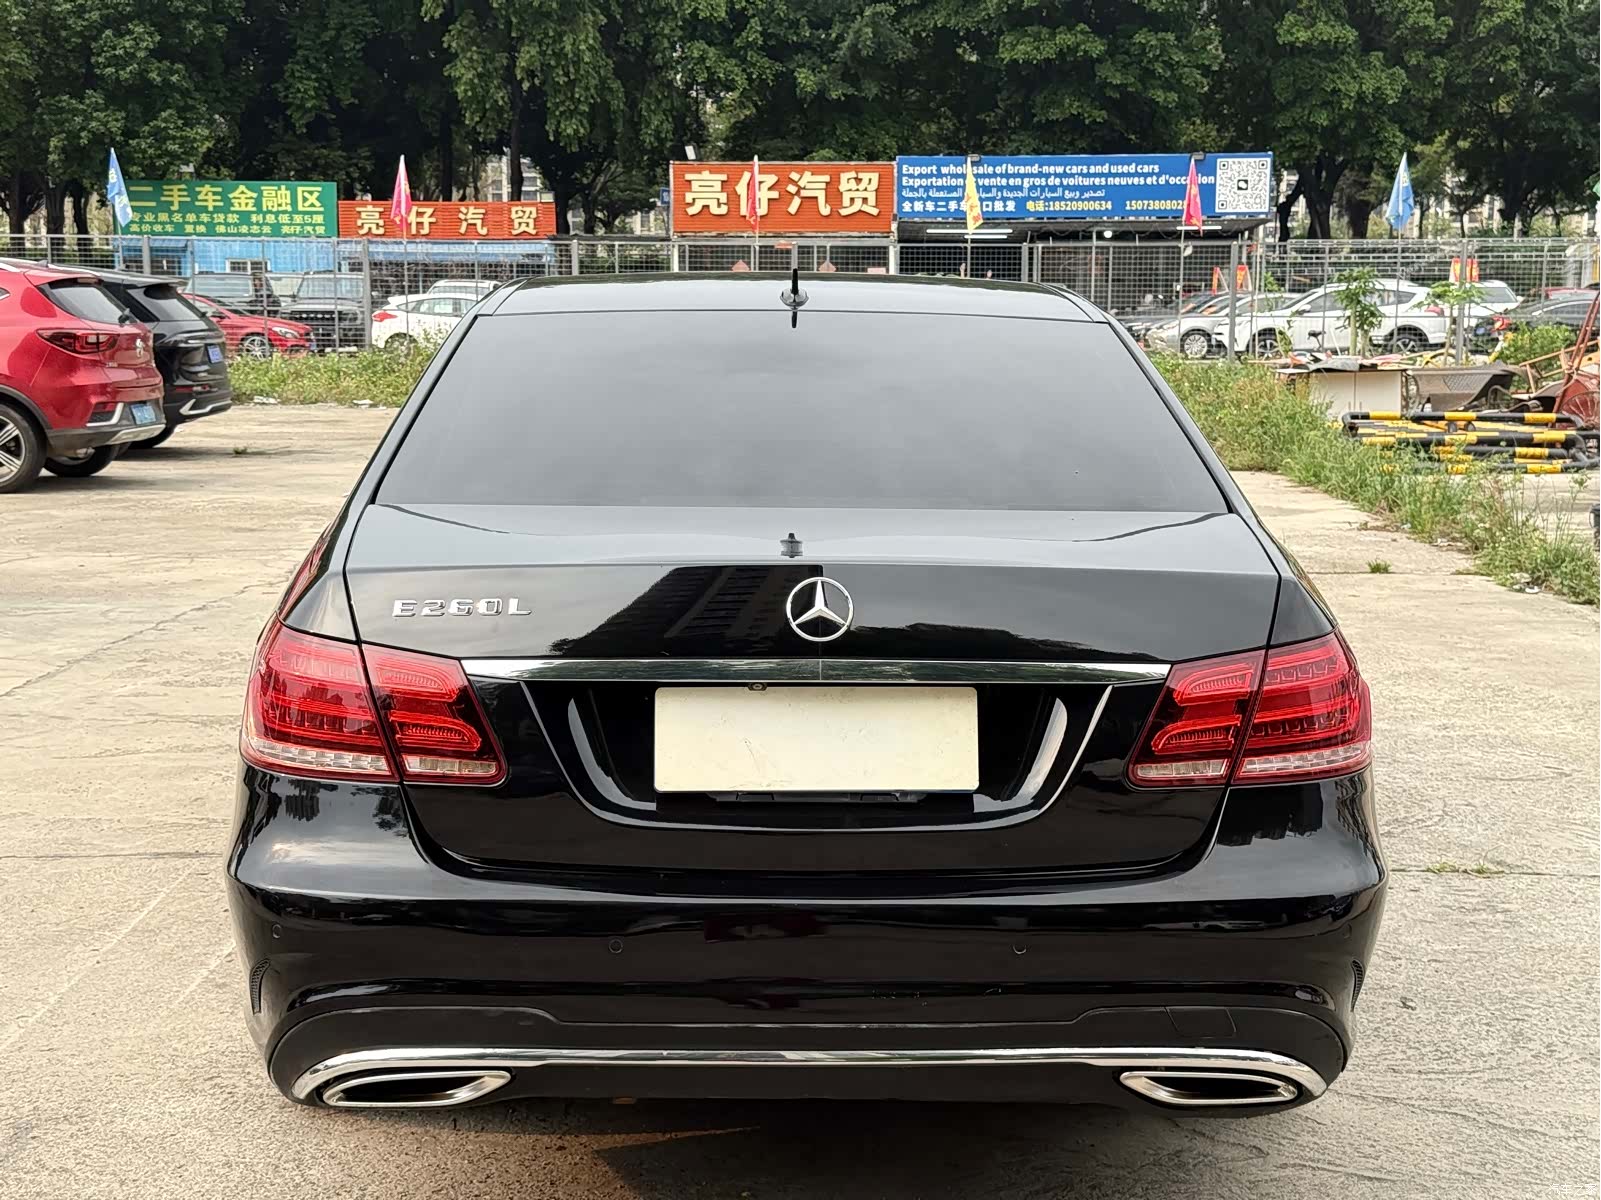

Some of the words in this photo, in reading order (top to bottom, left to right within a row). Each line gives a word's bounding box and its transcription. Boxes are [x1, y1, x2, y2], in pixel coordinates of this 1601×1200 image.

[902, 164, 937, 176] Export
[940, 164, 993, 174] wholsale
[995, 164, 1007, 174] of
[1008, 164, 1064, 174] brand-new
[1066, 165, 1088, 174] cars
[1089, 163, 1109, 173] and
[1111, 163, 1135, 173] used
[1137, 164, 1159, 173] cars
[902, 177, 963, 188] Exportation
[978, 177, 1007, 186] vente
[1008, 178, 1022, 186] en
[1023, 177, 1046, 188] gros
[1047, 176, 1060, 186] de
[1062, 175, 1106, 186] voitures
[1107, 176, 1144, 185] neuves
[1146, 175, 1157, 185] et
[128, 184, 325, 211] 二手车金融区
[684, 170, 880, 216] 亮仔汽贸
[1081, 189, 1105, 198] تصدير
[902, 200, 1016, 212] 全新车二手车口批发
[355, 204, 538, 236] 亮仔汽贸
[392, 598, 532, 617] E260L
